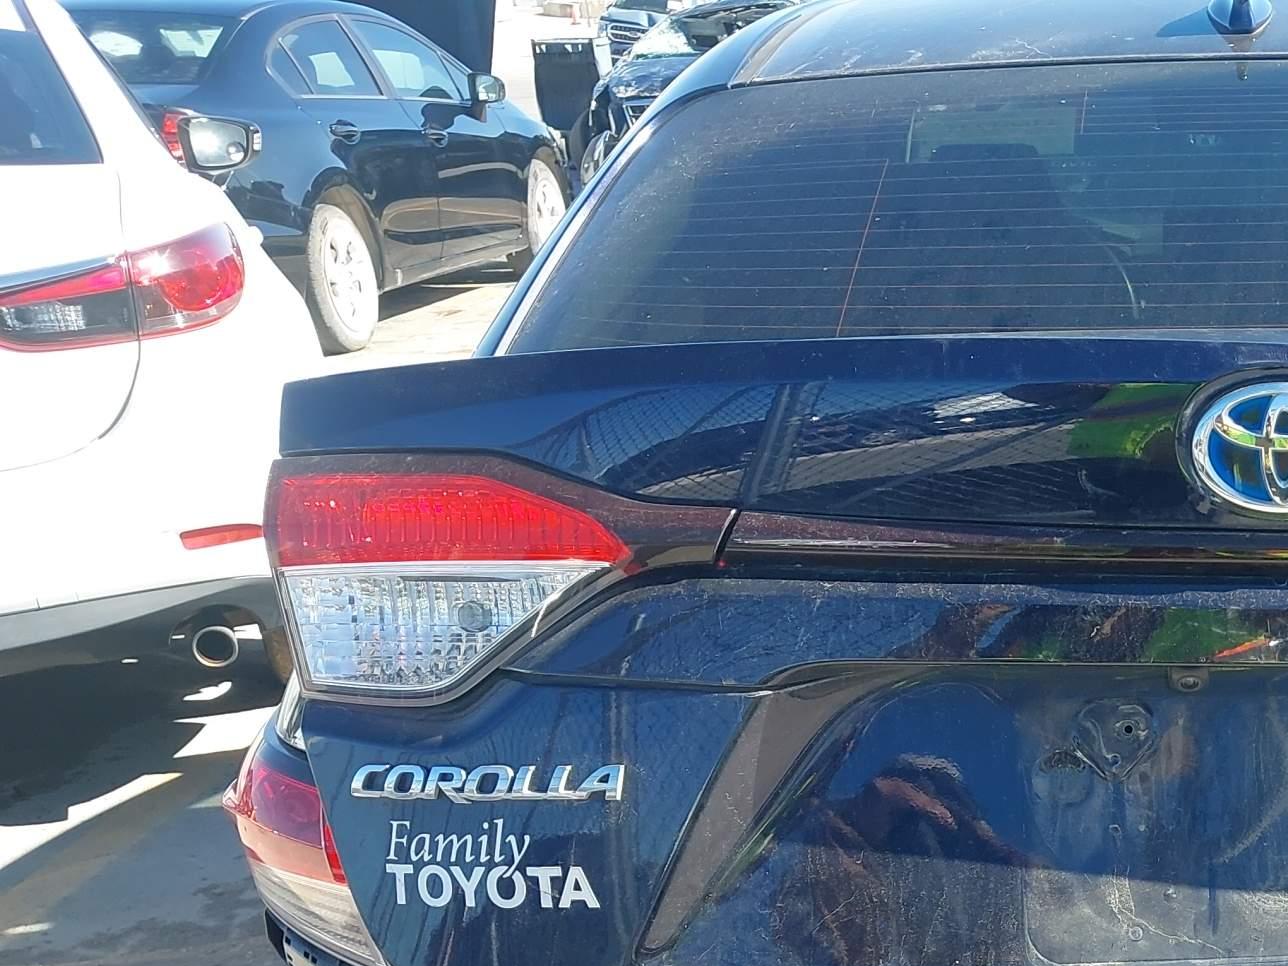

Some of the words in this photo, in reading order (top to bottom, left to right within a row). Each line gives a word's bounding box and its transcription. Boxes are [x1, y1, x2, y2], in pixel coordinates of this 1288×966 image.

[350, 763, 625, 804] COROLLA
[386, 818, 530, 878] Family
[385, 863, 600, 909] TOYOTA
